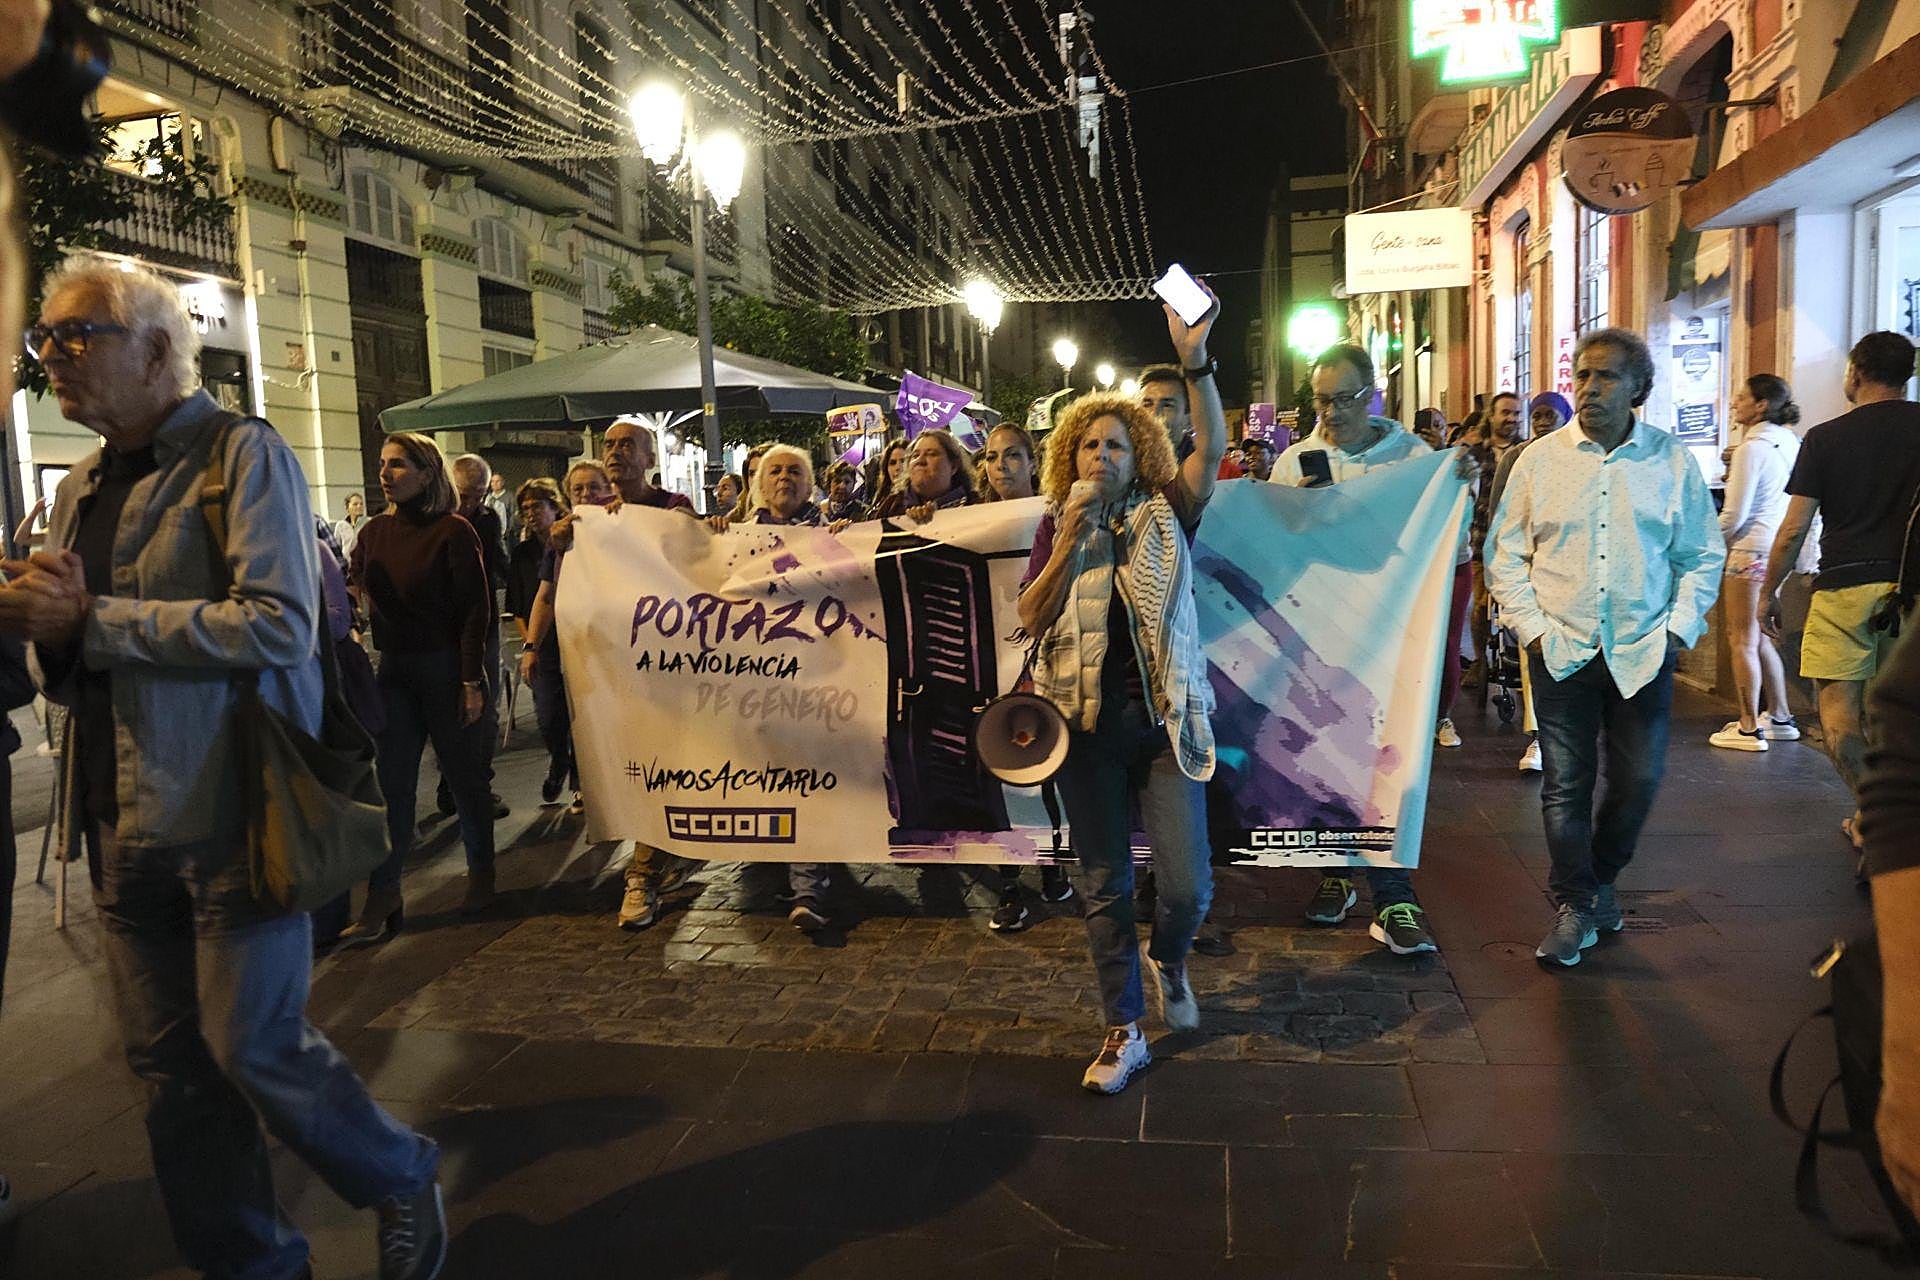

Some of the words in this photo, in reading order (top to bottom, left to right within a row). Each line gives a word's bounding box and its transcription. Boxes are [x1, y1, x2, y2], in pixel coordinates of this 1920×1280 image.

[631, 593, 846, 648] PORTAZO
[636, 650, 653, 672] A
[659, 648, 684, 675] LA
[685, 652, 801, 681] VIOLENCIA
[694, 682, 731, 717] DE
[669, 813, 756, 836] CCOO
